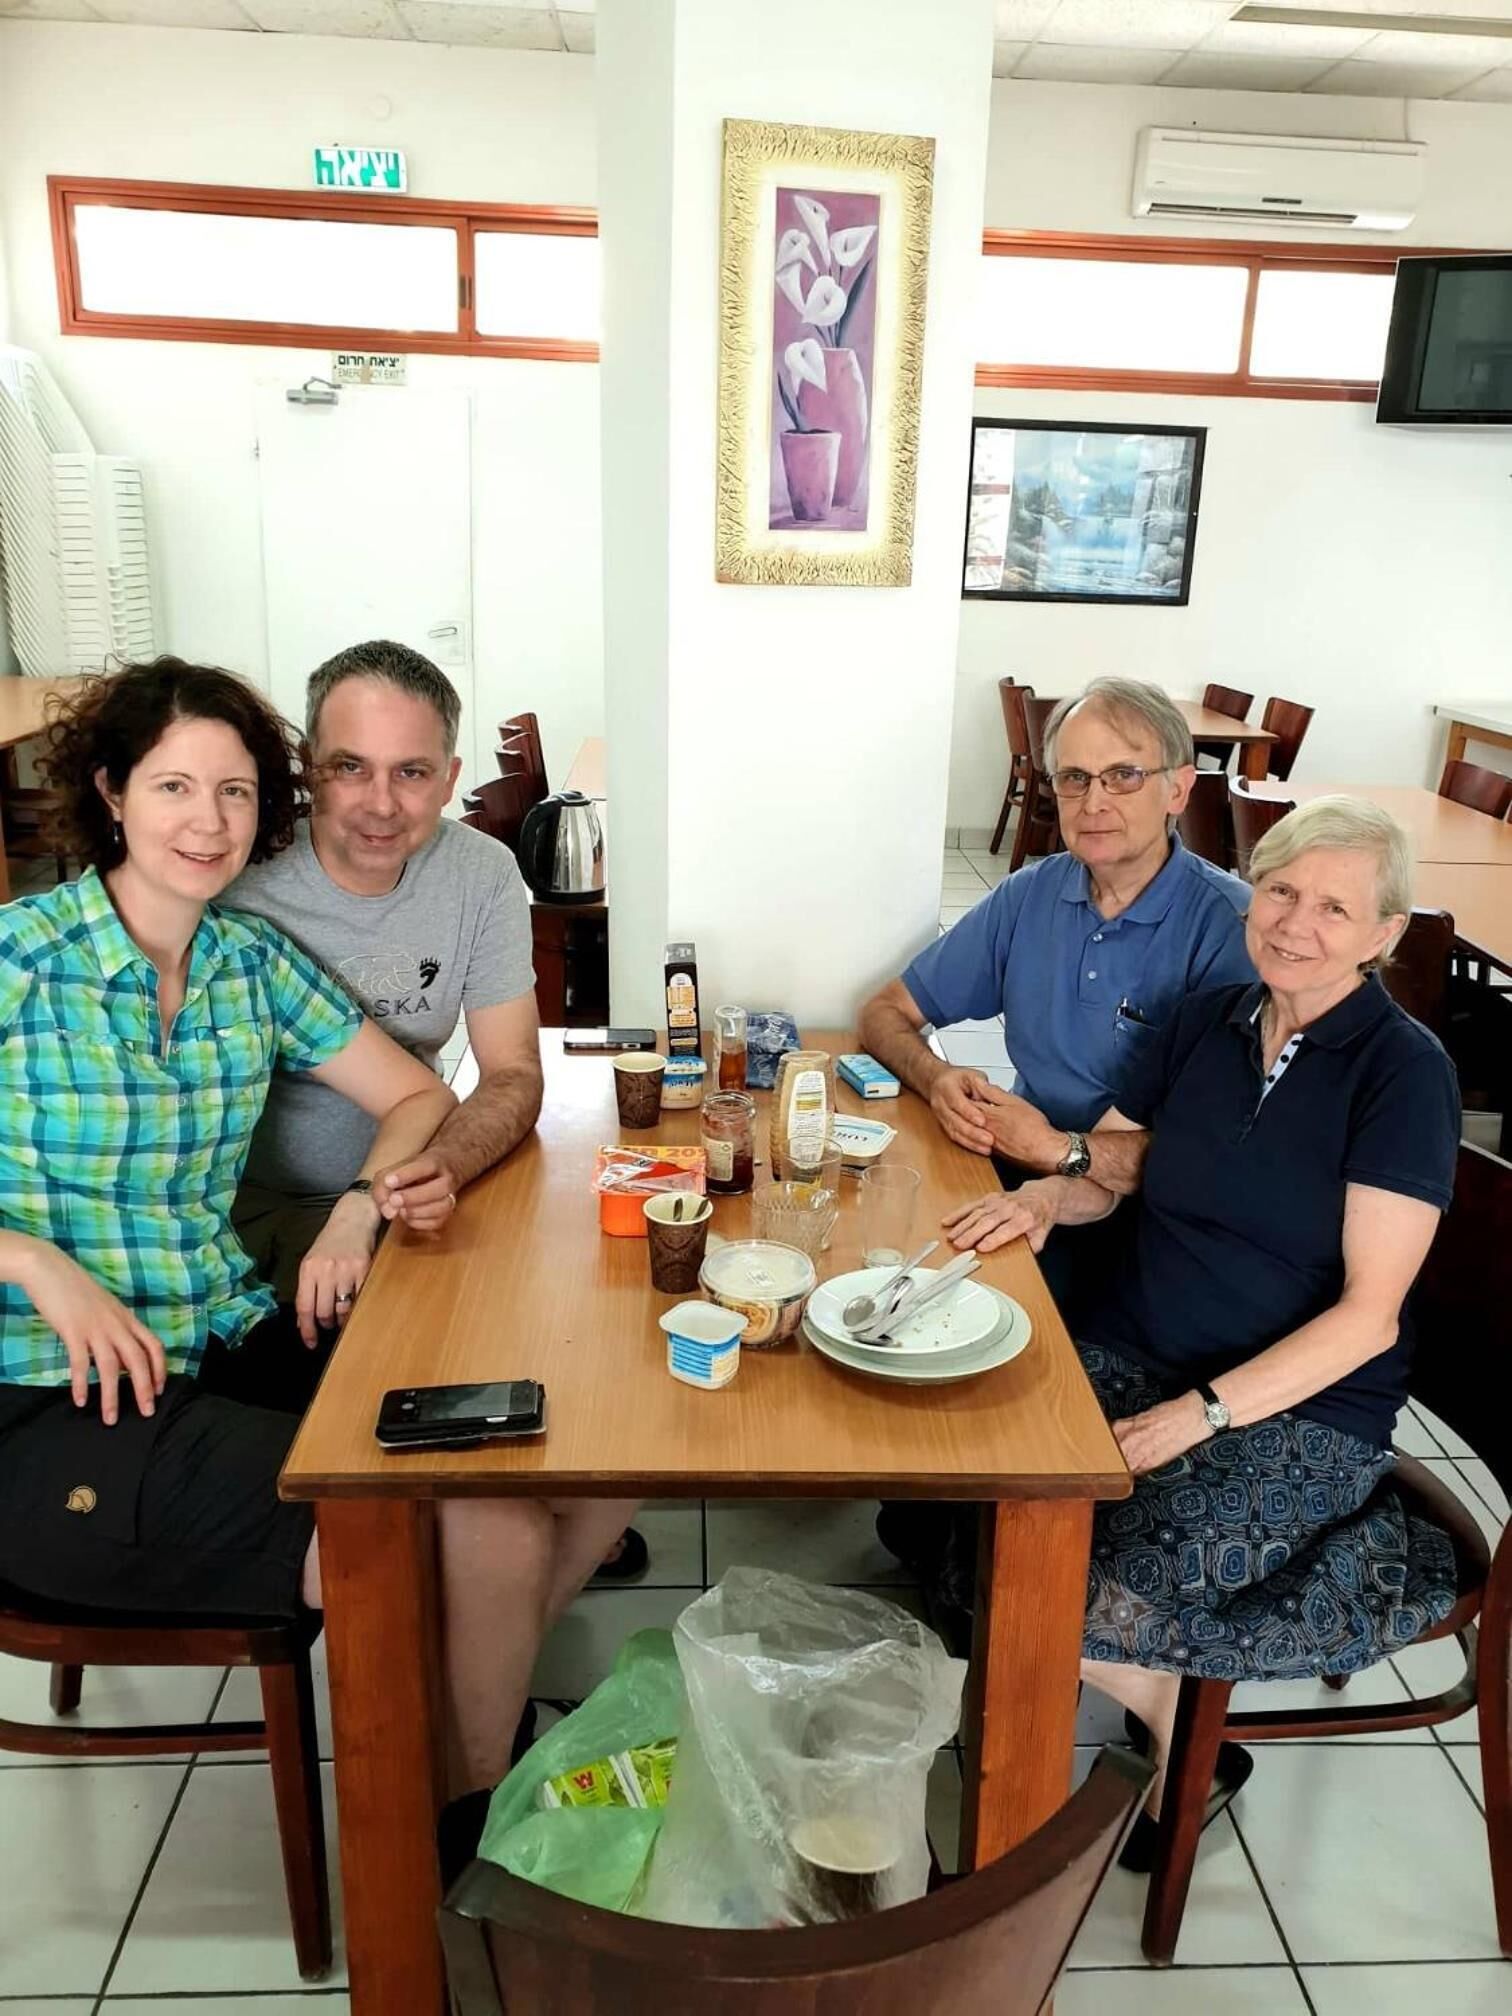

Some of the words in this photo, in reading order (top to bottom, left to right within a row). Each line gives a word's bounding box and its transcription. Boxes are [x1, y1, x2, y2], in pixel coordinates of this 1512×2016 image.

[317, 149, 397, 187] יציאה
[338, 355, 364, 366] חרום
[369, 356, 400, 368] יציאת
[374, 995, 432, 1017] SKA
